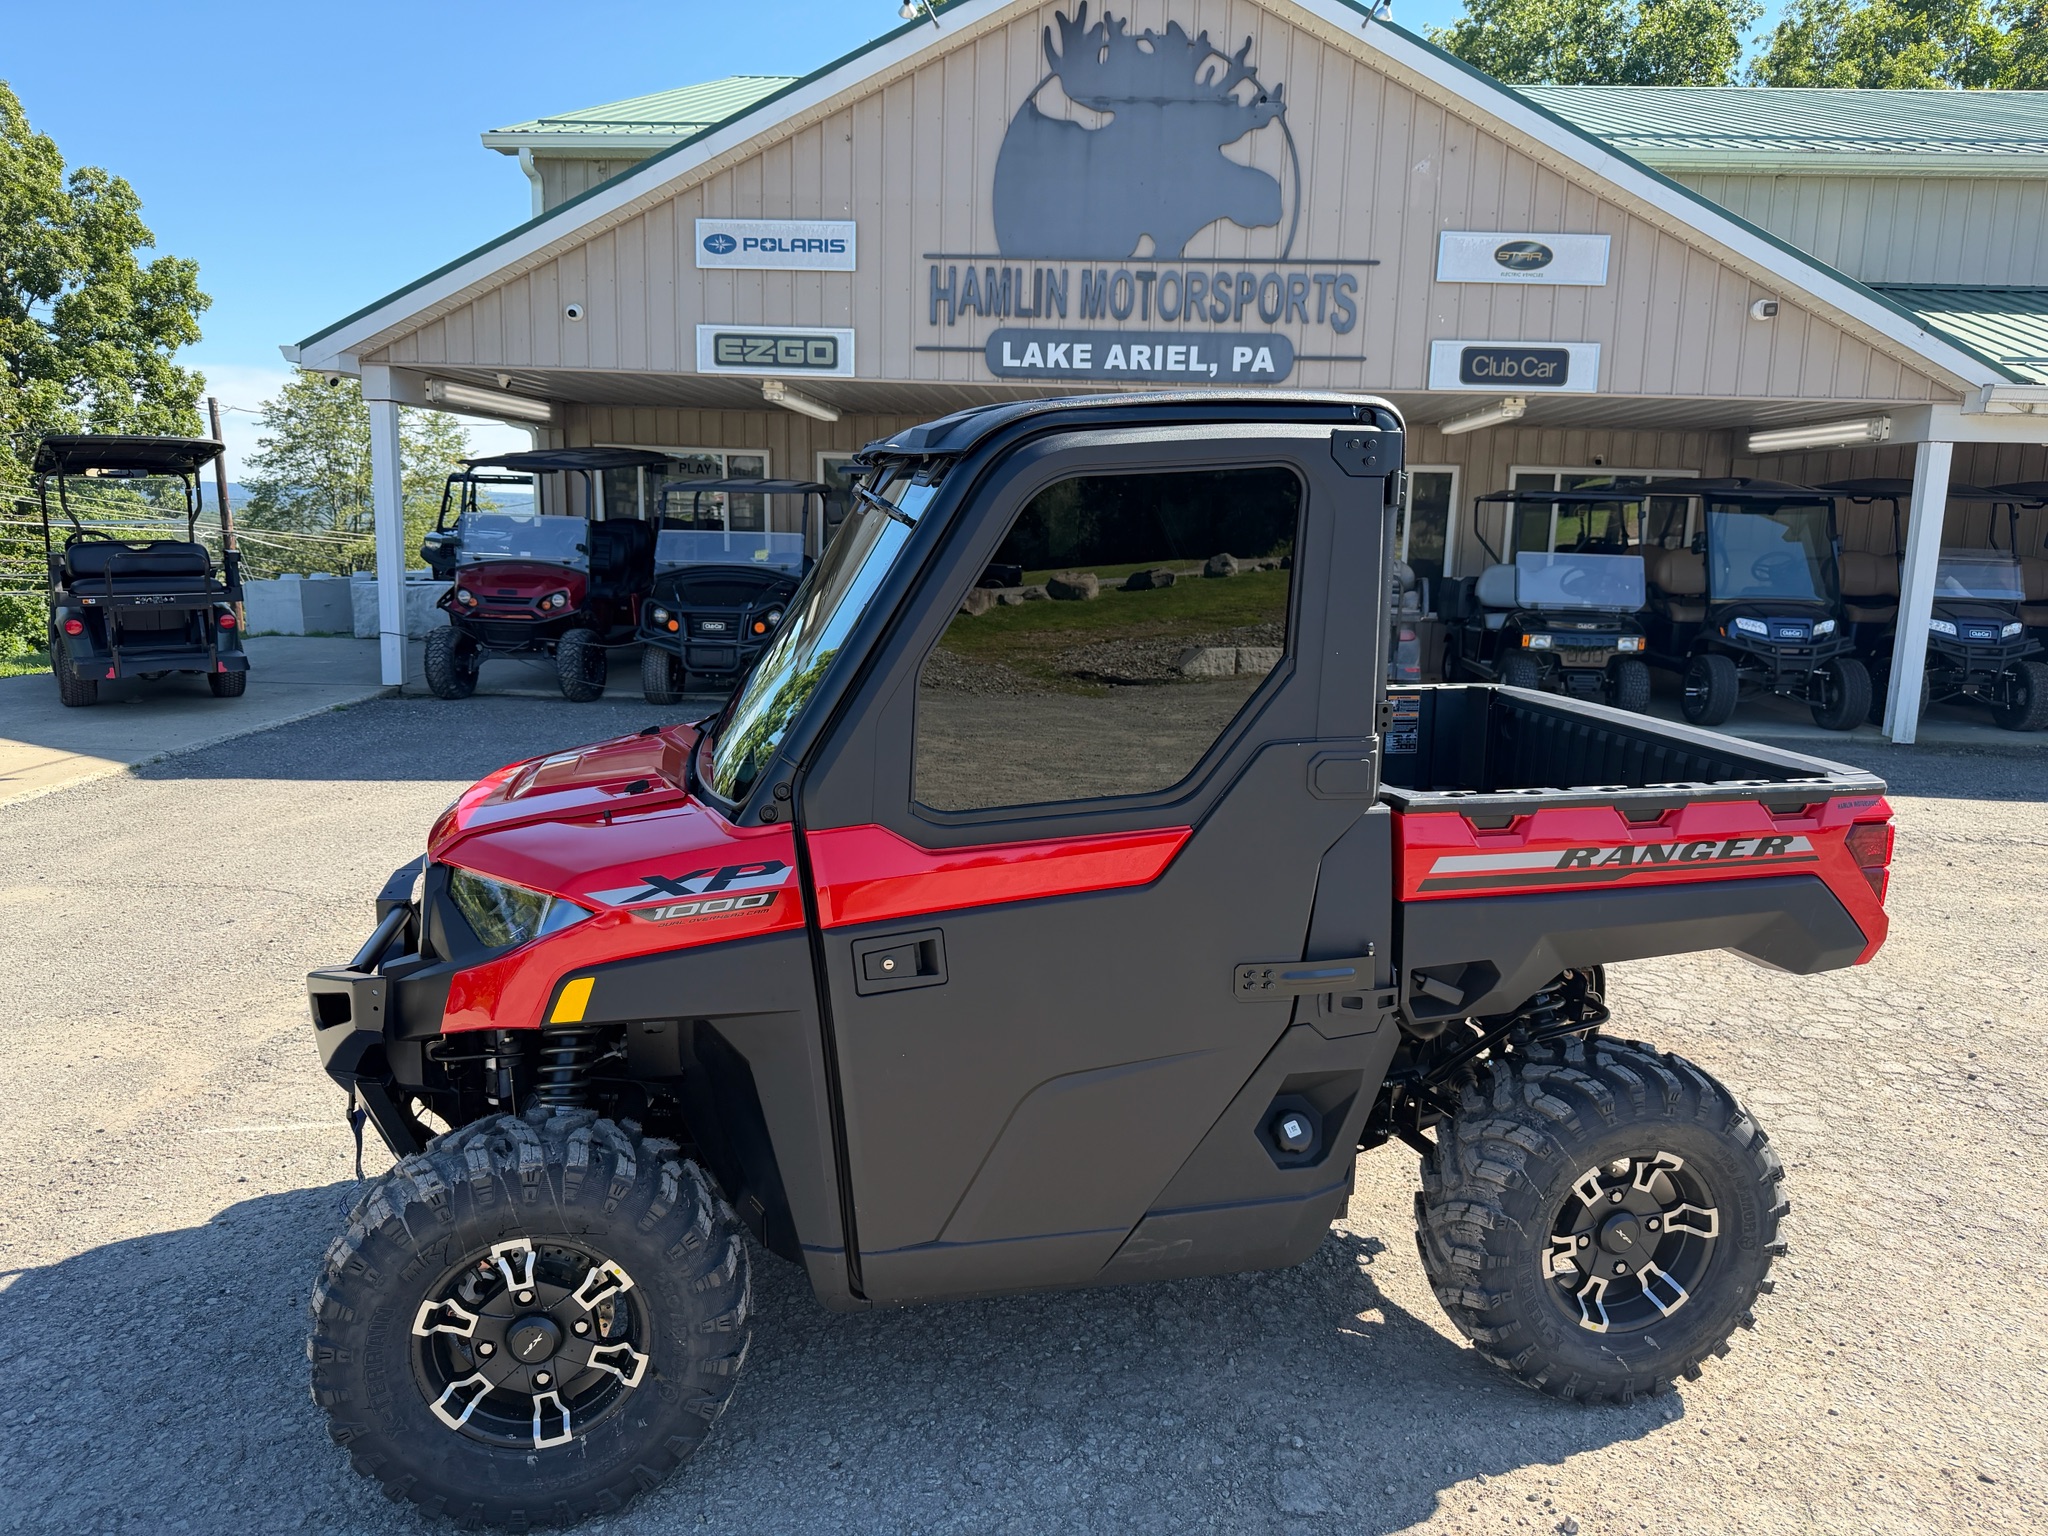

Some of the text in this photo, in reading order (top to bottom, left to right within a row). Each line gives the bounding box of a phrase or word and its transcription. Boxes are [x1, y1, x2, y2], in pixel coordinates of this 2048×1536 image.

[743, 237, 846, 254] POLARIS
[930, 265, 1358, 335] HAMLIN MOTORSPORTS
[1002, 341, 1276, 378] LAKE ARIEL, PA
[1471, 355, 1558, 378] Club Car
[678, 462, 712, 475] PLAY
[1554, 835, 1794, 869] RANGER
[617, 860, 788, 904] XP
[653, 893, 770, 920] 1000
[657, 908, 770, 928] DUAL OVERHEAD CAM
[363, 1305, 409, 1441] X-TERRAIN
